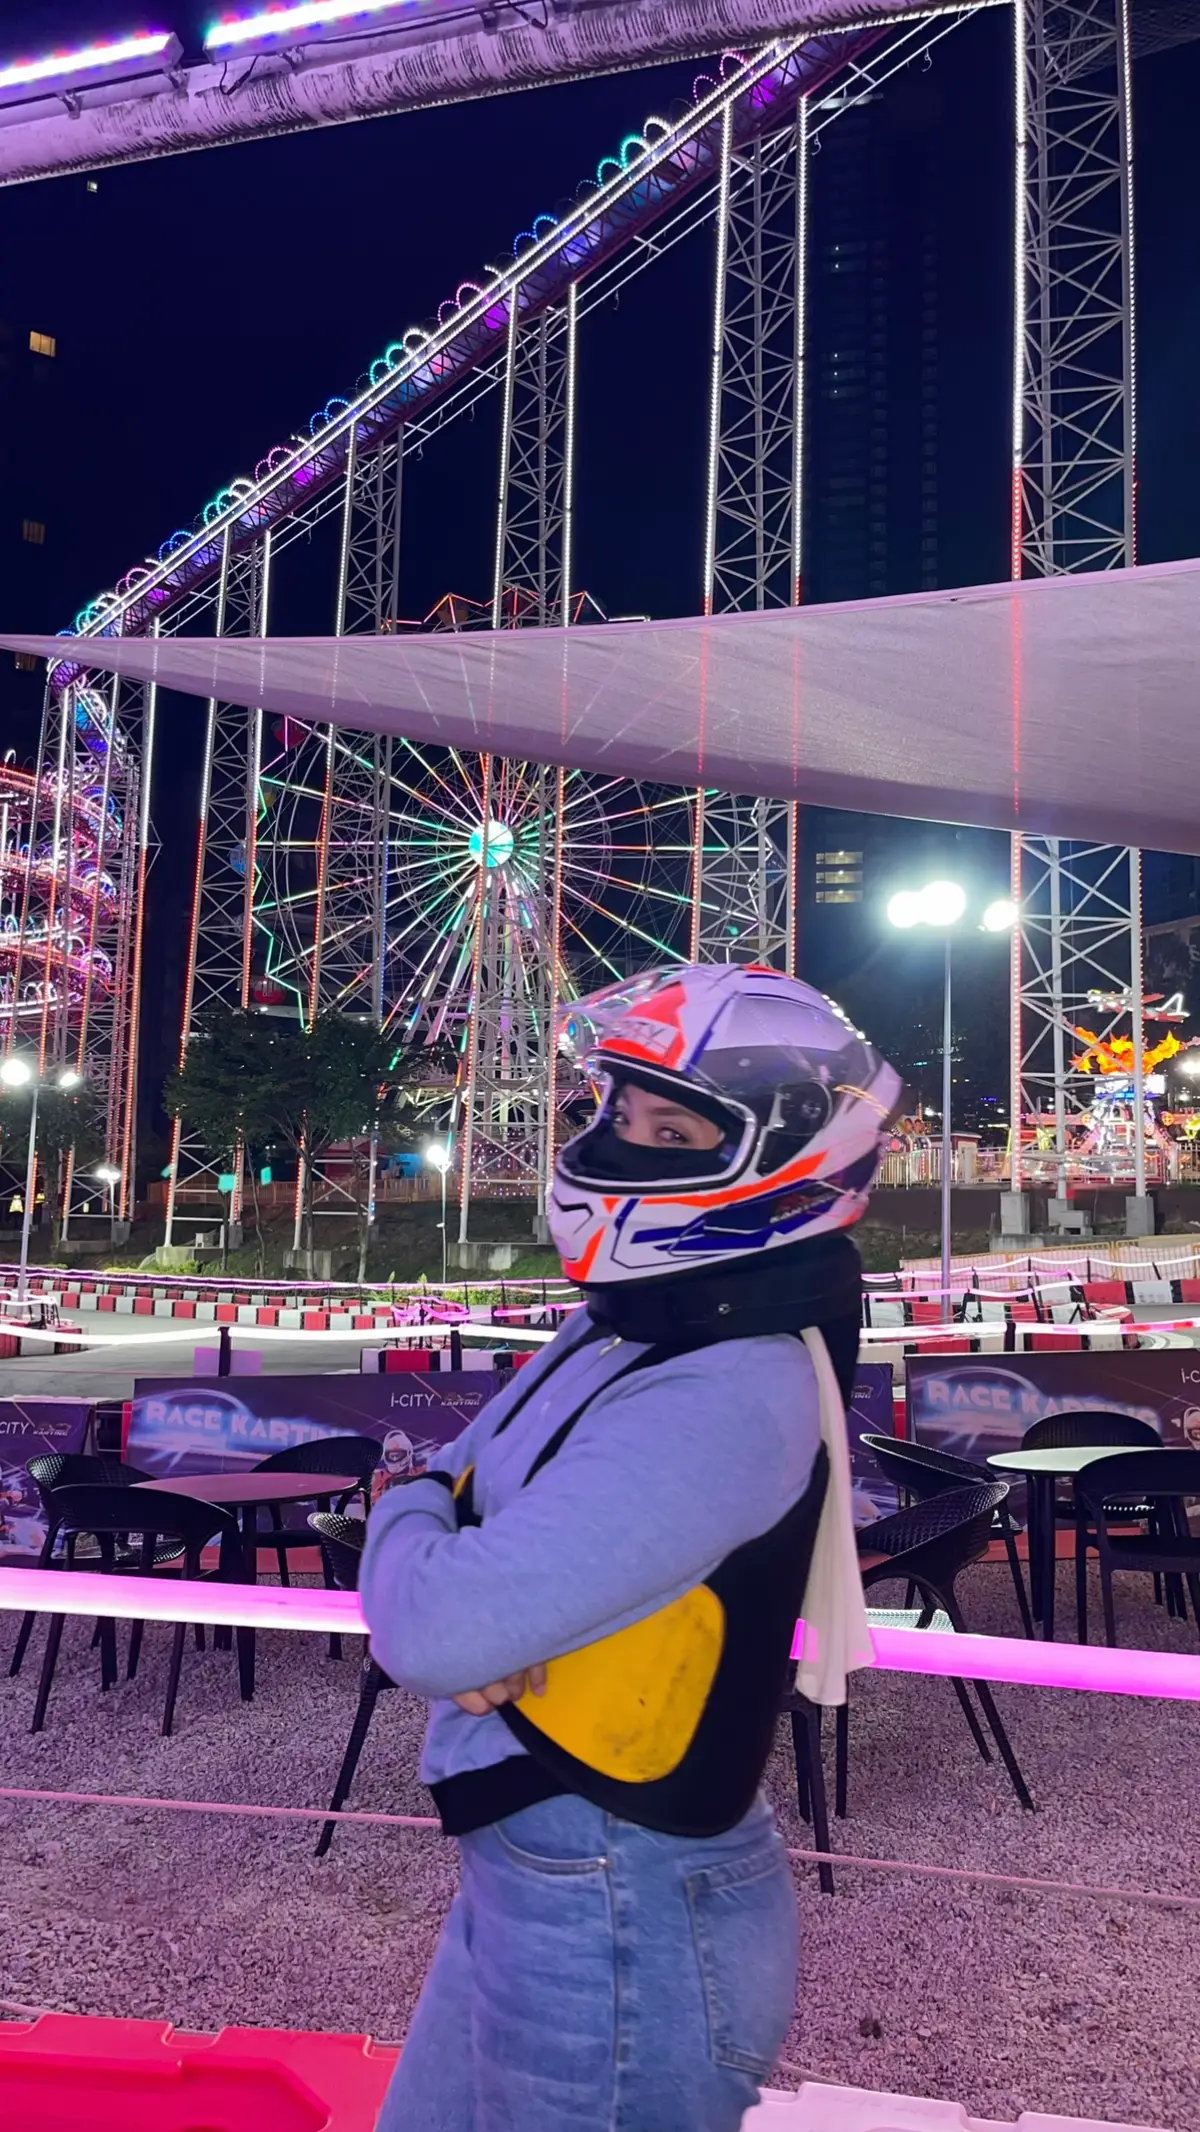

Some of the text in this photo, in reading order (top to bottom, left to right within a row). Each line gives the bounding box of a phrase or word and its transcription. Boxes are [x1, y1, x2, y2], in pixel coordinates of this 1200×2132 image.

[927, 1379, 1011, 1411] RACE
[146, 1400, 360, 1446] RACE KARTI
